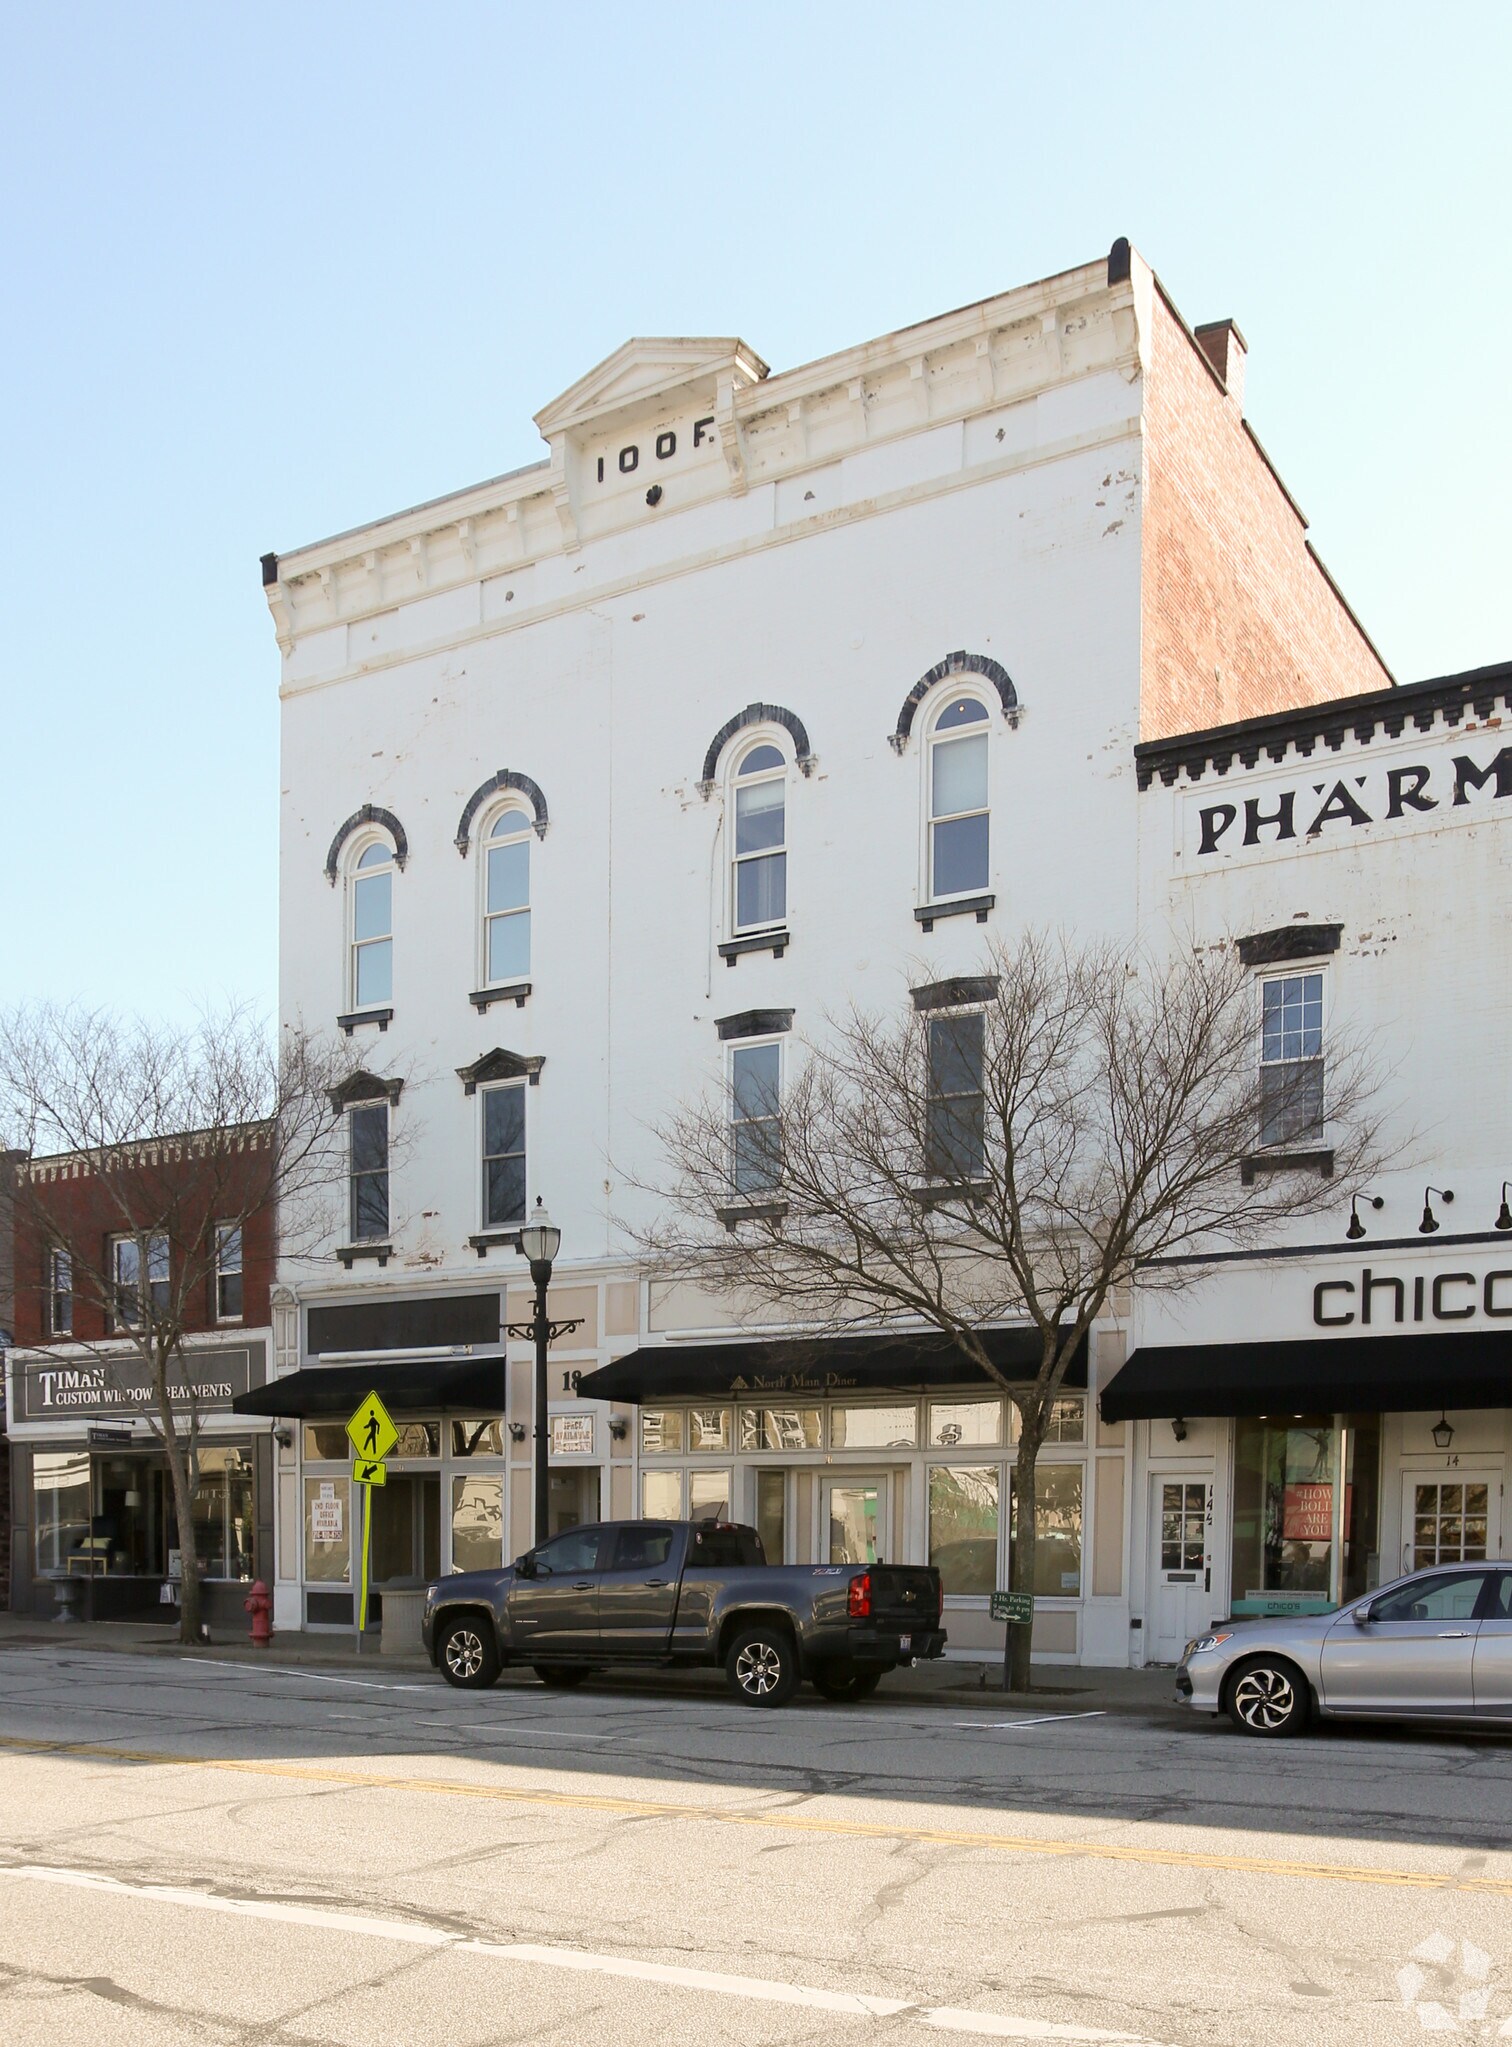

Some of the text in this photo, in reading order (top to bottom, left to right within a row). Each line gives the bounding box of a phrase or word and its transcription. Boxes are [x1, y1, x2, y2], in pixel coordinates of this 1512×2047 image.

[754, 1372, 857, 1388] North Main Diner
[39, 1369, 105, 1405] TIMAN
[56, 1390, 101, 1405] CUSTOM
[1446, 1455, 1460, 1467] 14
[1304, 1513, 1329, 1524] ARE
[1303, 1524, 1329, 1536] YOU
[1009, 1596, 1031, 1606] Parking
[1267, 1602, 1301, 1611] chico's
